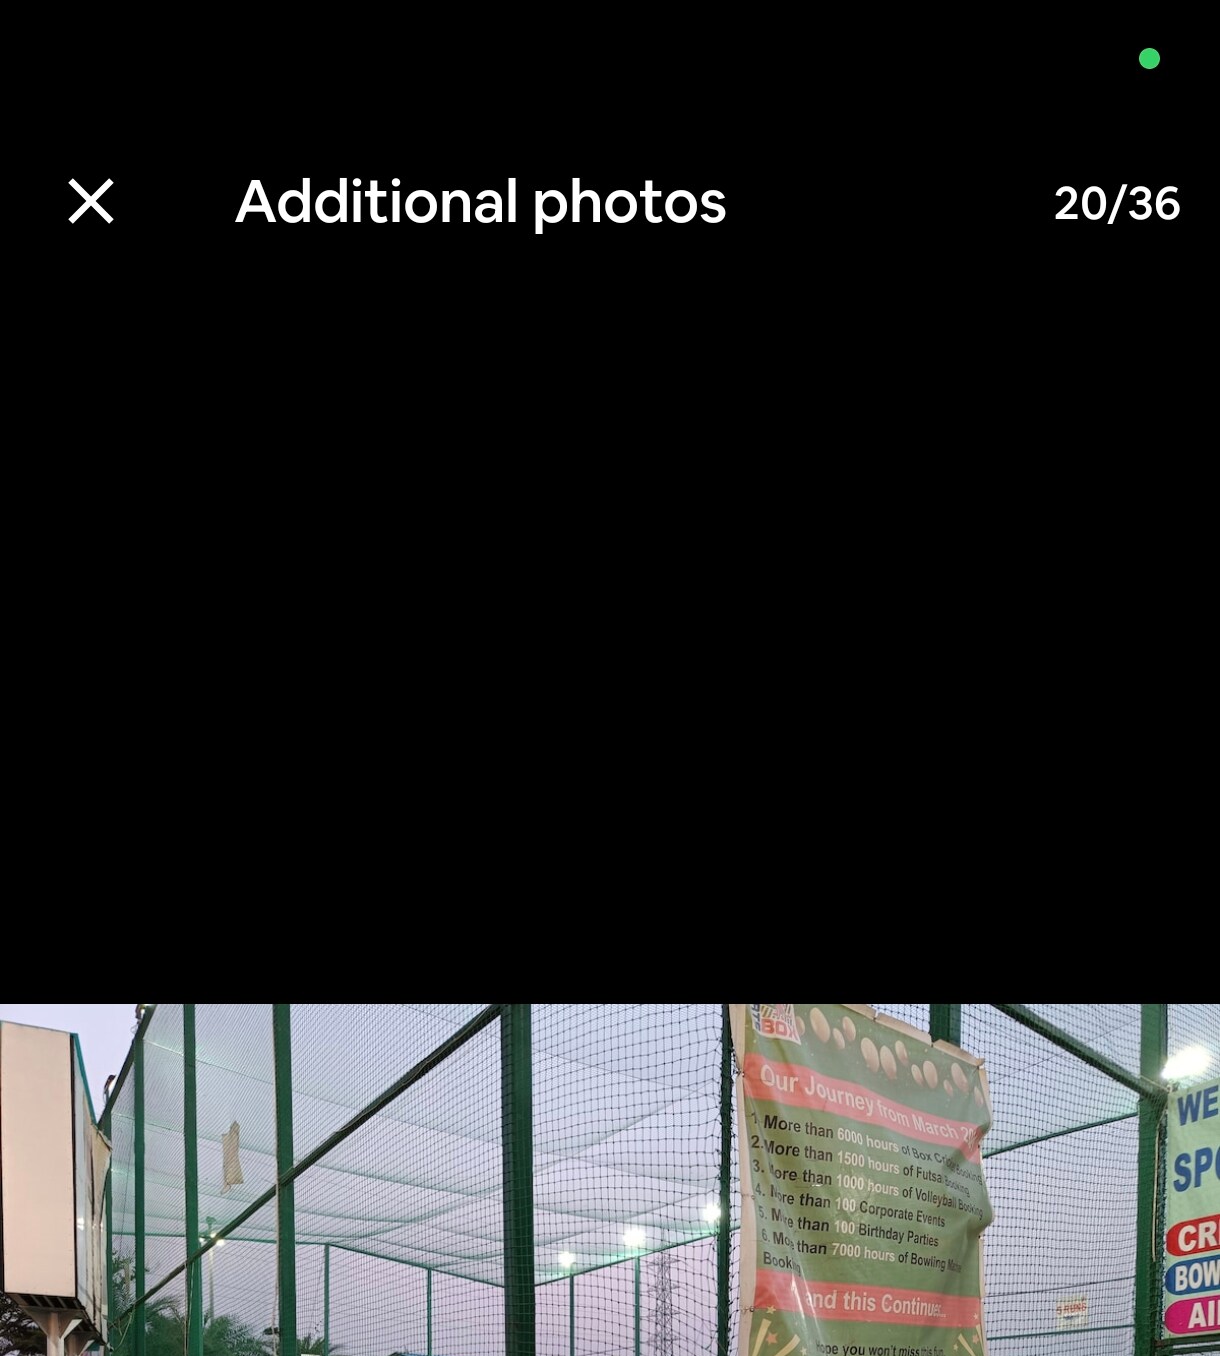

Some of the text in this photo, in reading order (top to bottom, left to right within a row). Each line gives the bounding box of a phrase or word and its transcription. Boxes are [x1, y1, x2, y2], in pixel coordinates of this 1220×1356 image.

[761, 1064, 798, 1093] Our
[805, 1076, 873, 1117] Journey
[877, 1098, 910, 1128] from
[912, 1113, 959, 1140] March
[764, 1114, 801, 1133] More
[805, 1122, 833, 1139] than
[837, 1128, 862, 1145] 6000
[866, 1135, 899, 1153] hours
[901, 1145, 910, 1156] of
[912, 1147, 933, 1162] Box
[804, 1146, 833, 1162] than
[837, 1150, 865, 1168] 1500
[868, 1157, 900, 1175] hours
[903, 1165, 914, 1177] of
[916, 1166, 944, 1185] Futsa
[802, 1169, 832, 1185] than
[836, 1174, 864, 1191] 1000
[867, 1179, 899, 1196] hours
[902, 1186, 913, 1199] of
[915, 1187, 957, 1209] Volleyball
[799, 1193, 831, 1208] than
[835, 1196, 856, 1212] 100
[860, 1200, 914, 1221] Corporate
[916, 1210, 946, 1228] Events
[798, 1217, 830, 1232] than
[834, 1220, 855, 1235] 100
[859, 1223, 905, 1244] Birthday
[907, 1230, 939, 1247] Parties
[1178, 1220, 1220, 1252] CR
[797, 1240, 827, 1255] than
[831, 1242, 861, 1258] 7000
[864, 1246, 896, 1262] hours
[898, 1251, 909, 1263] of
[911, 1252, 946, 1272] Bowling
[843, 1291, 876, 1312] this
[1187, 1299, 1220, 1329] AI
[868, 1345, 897, 1356] won't
